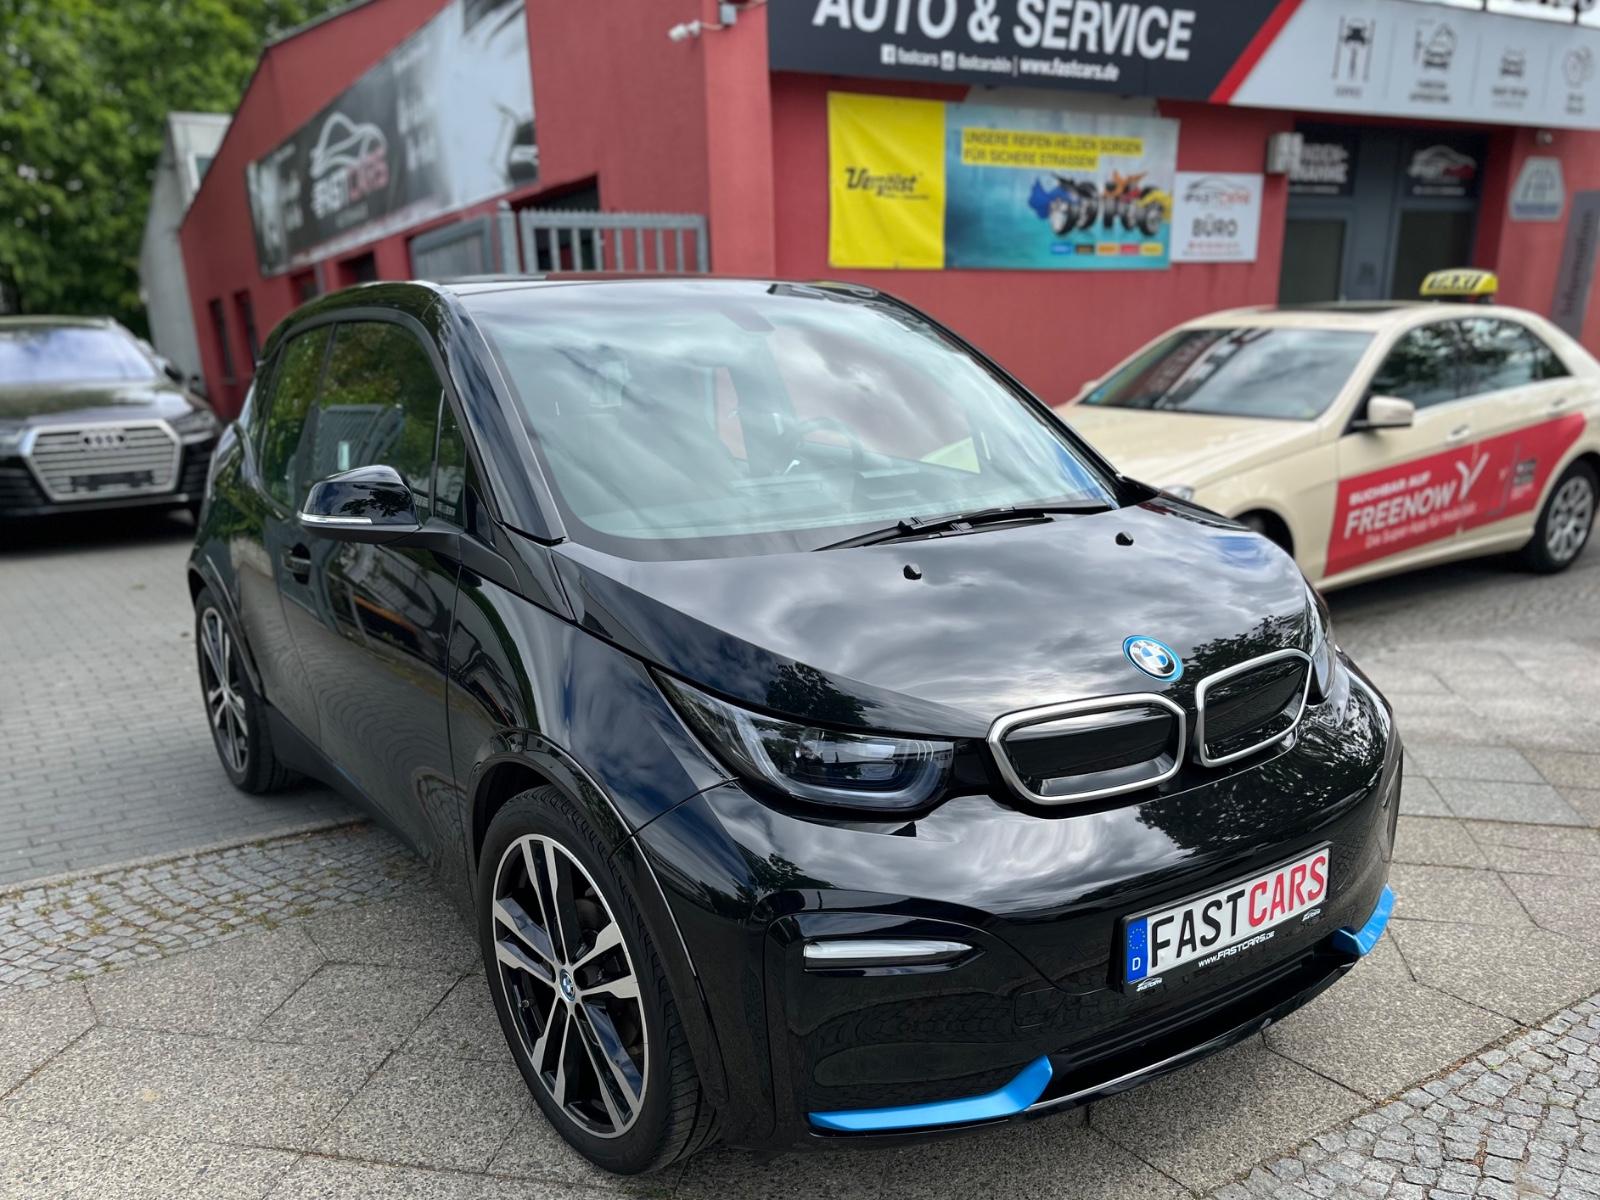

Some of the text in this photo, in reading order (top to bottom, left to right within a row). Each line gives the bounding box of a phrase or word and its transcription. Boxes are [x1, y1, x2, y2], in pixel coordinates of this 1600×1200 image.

[812, 0, 1196, 61] AUTO & SERVICE
[1192, 212, 1238, 237] BÜRO
[1427, 273, 1482, 290] TAXI
[1344, 480, 1457, 539] FREENOW
[1151, 856, 1326, 968] FASTCARS
[1131, 957, 1141, 972] D
